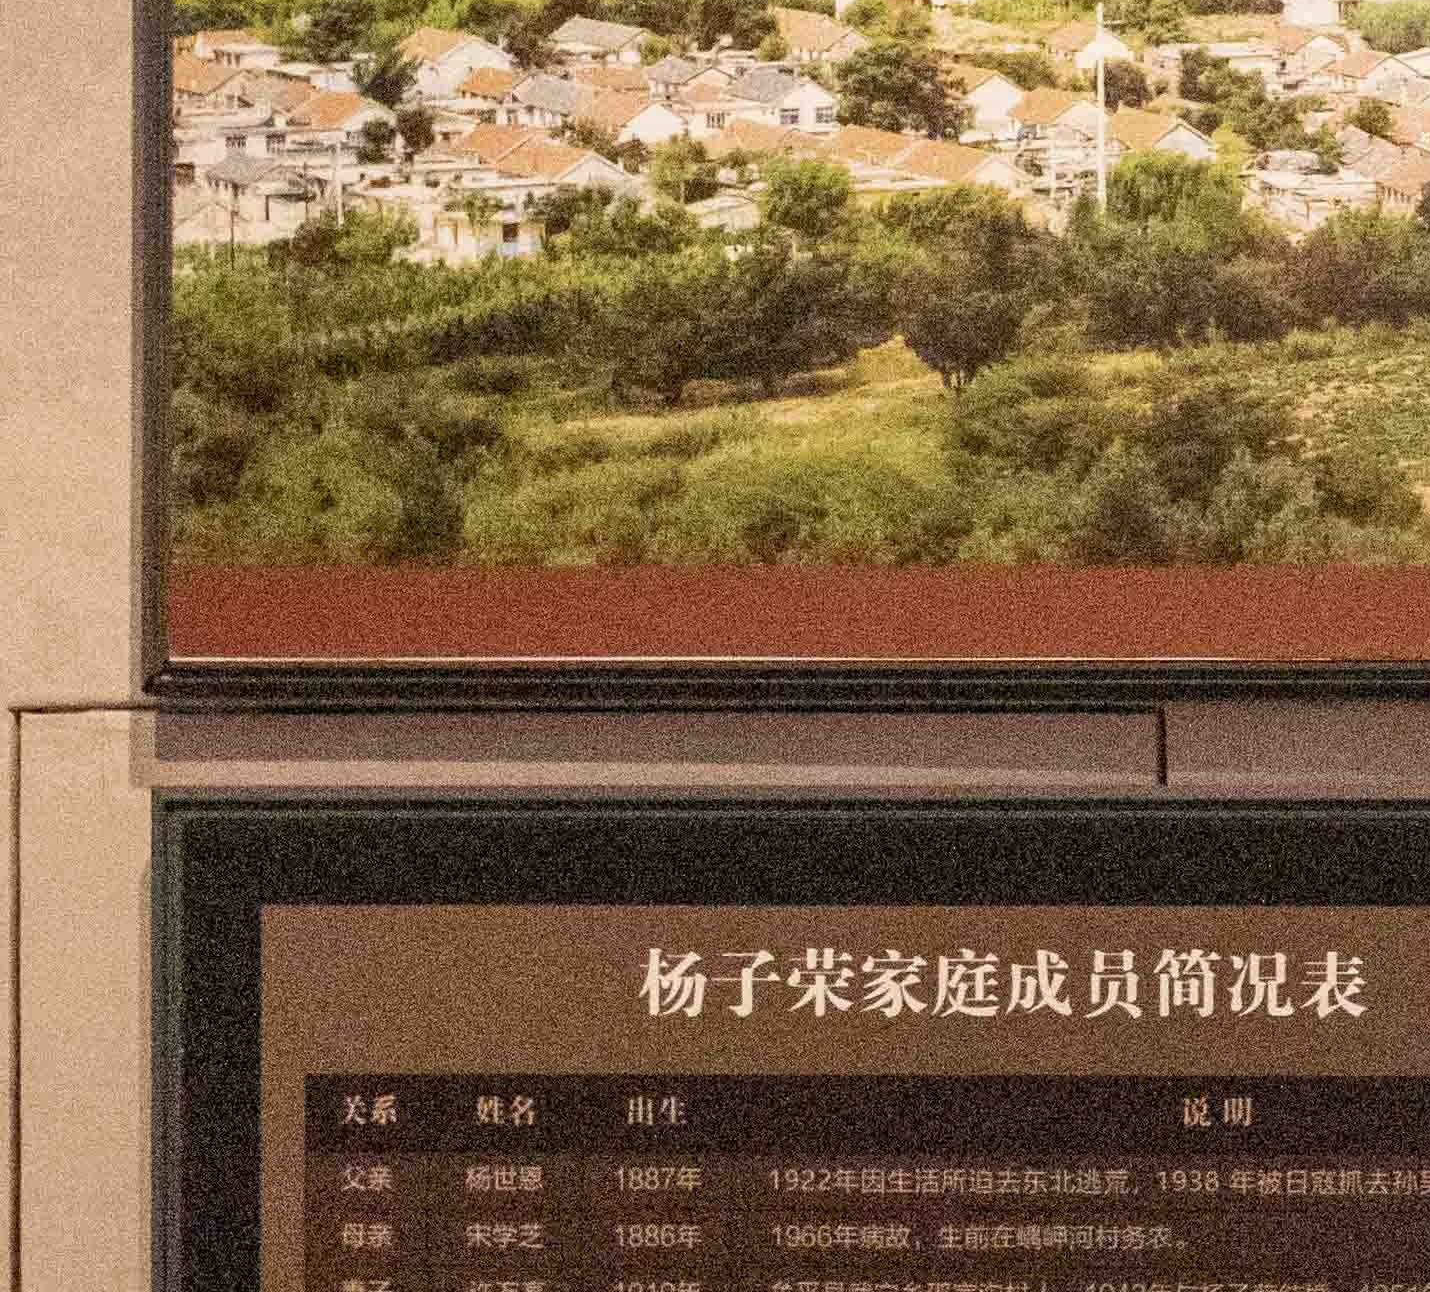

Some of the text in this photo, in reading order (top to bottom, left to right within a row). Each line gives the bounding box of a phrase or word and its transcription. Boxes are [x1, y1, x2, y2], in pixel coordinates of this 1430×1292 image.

[638, 946, 1368, 1019] 杨子荣家庭成员简况表
[342, 1094, 1253, 1128] 关系 姓名 出生 说明
[342, 1165, 391, 1192] 父亲
[615, 1165, 701, 1192] 1887年
[341, 1222, 392, 1249] 母亲
[615, 1223, 701, 1249] 1886年
